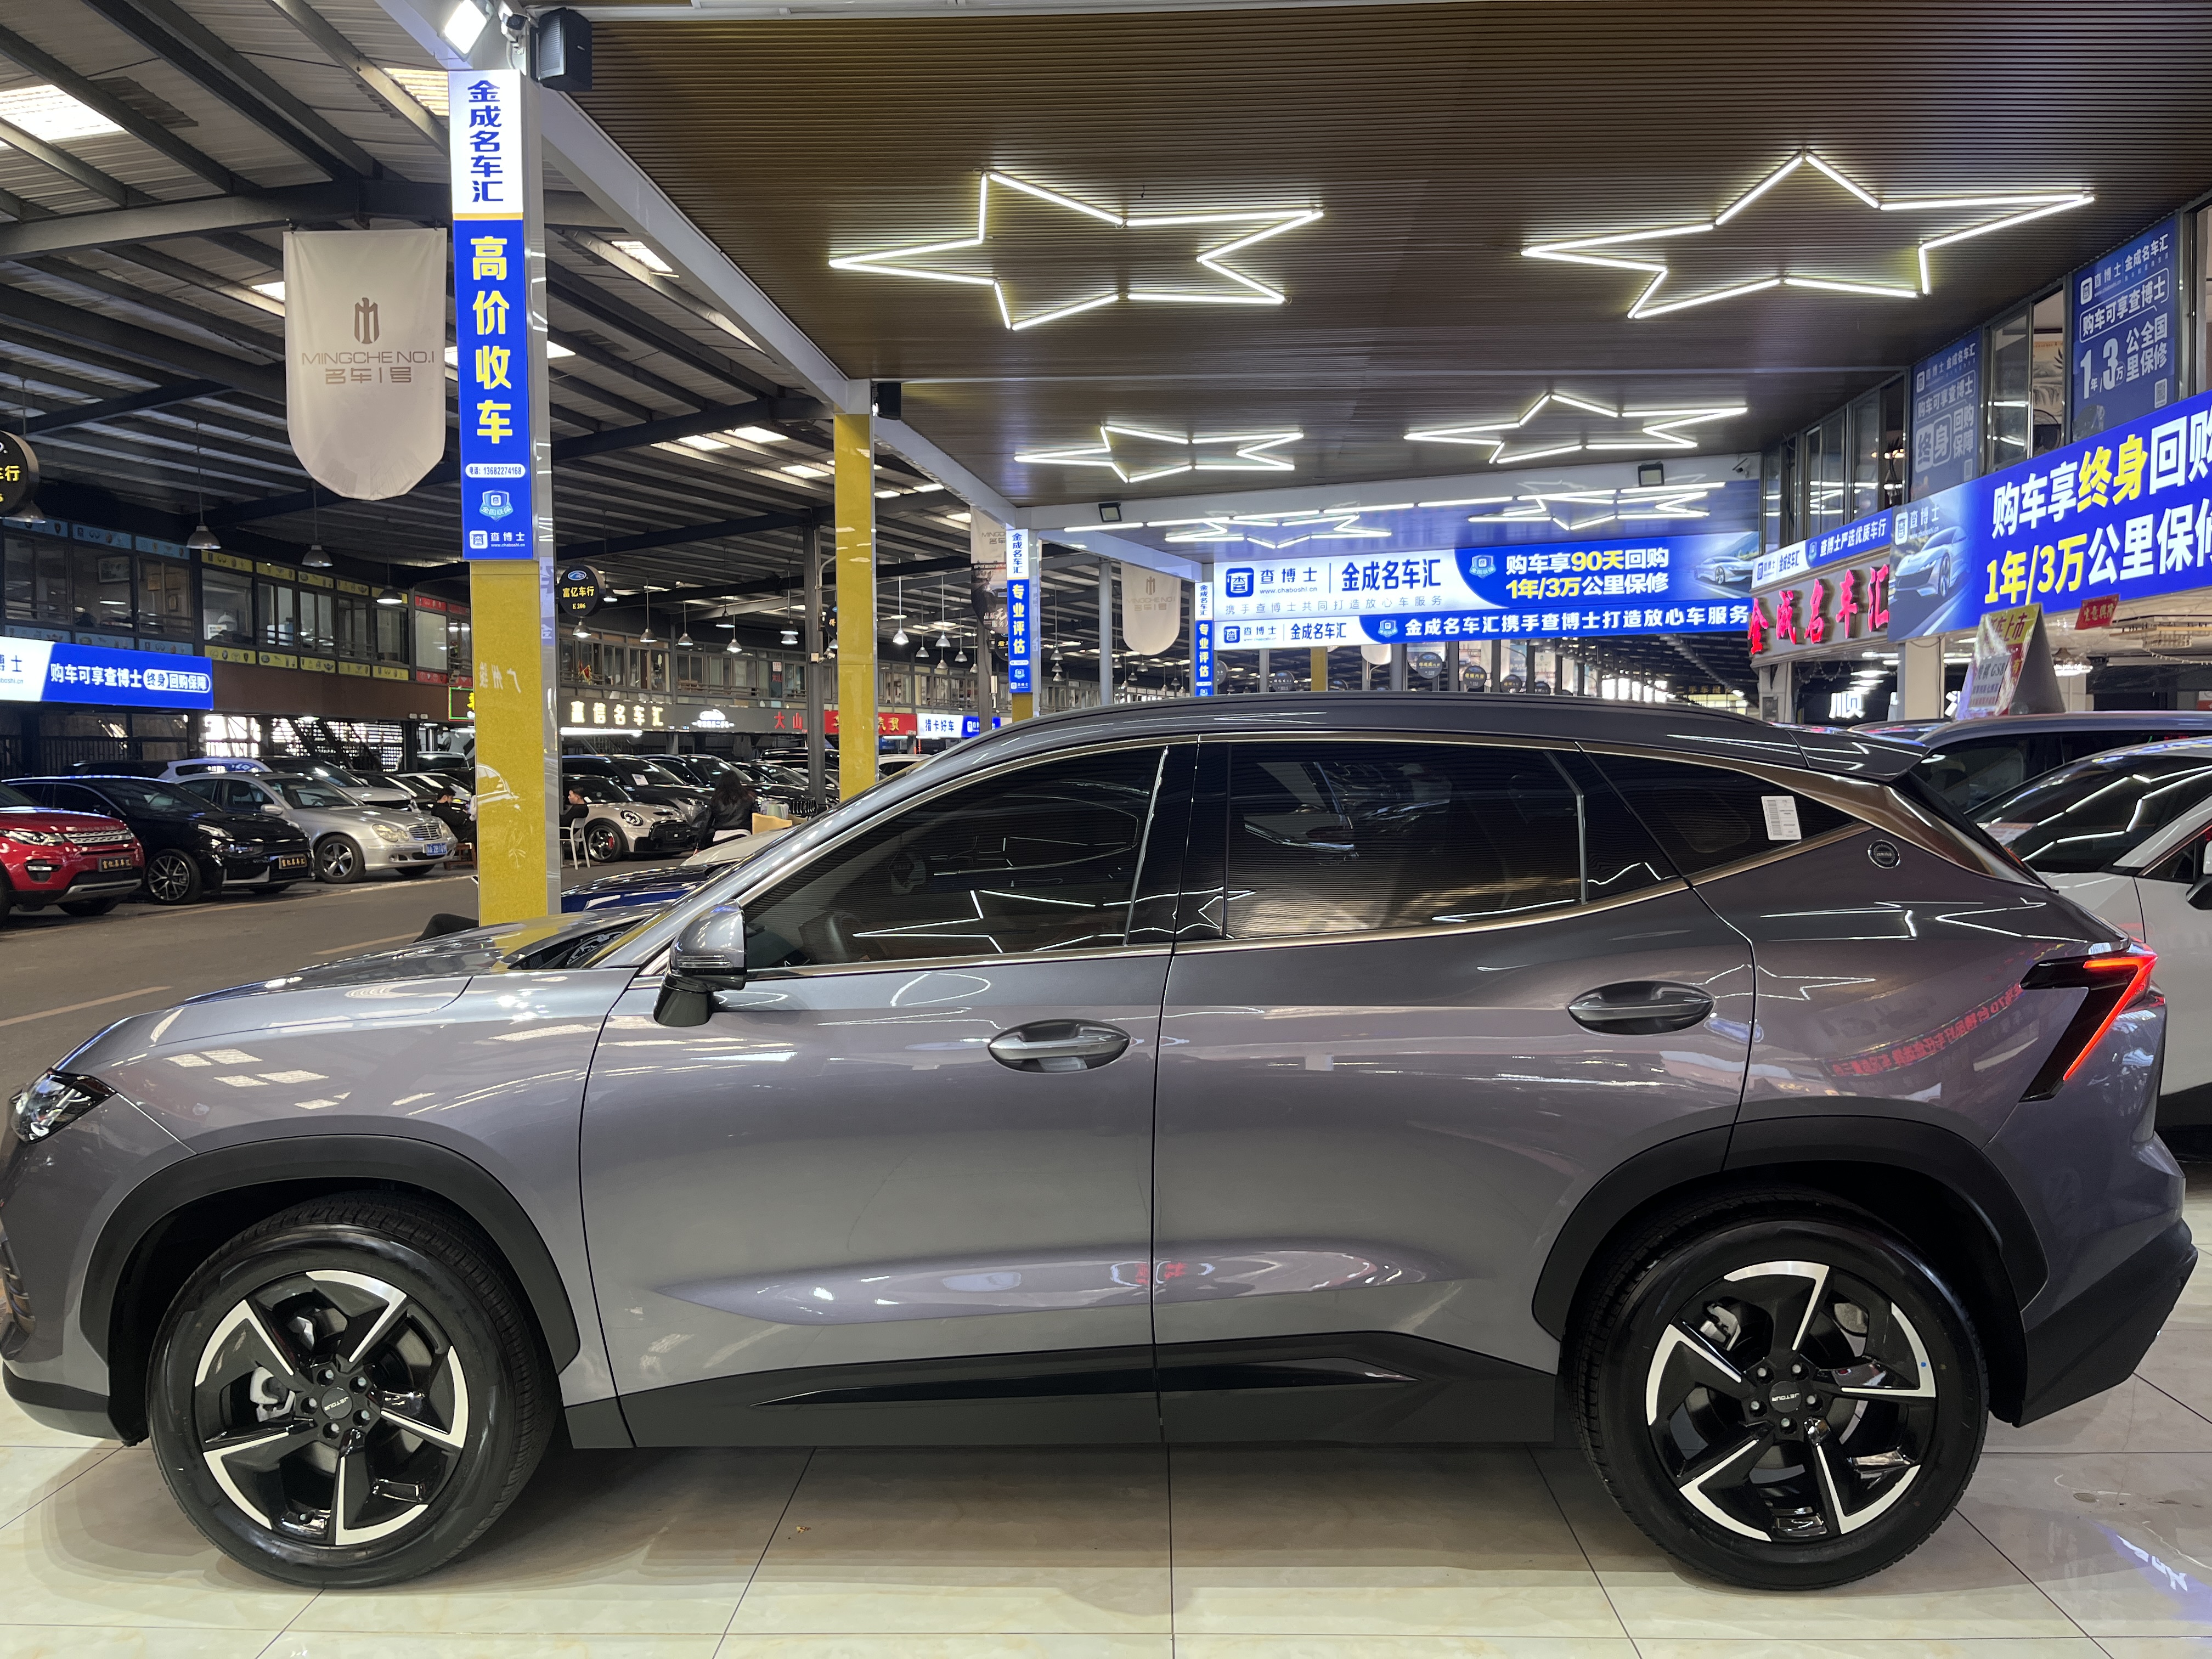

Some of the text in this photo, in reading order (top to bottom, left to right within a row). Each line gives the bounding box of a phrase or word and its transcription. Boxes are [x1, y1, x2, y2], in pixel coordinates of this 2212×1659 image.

[467, 80, 504, 203] 金成名车汇
[2125, 233, 2169, 272] 金成名车汇
[2083, 275, 2166, 337] 购车可享查博士
[470, 235, 514, 444] 高价收车
[302, 351, 393, 365] MINGCHE
[1917, 375, 1973, 419] 购车可享查博士
[490, 532, 525, 541] 查博士
[1819, 517, 1887, 557] 查博士严选优质车行
[1012, 533, 1023, 574] 金成名车汇
[1505, 547, 1669, 575] 购车享90天回购
[1260, 567, 1318, 585] 查博士
[1341, 558, 1442, 592] 金成名车汇
[1505, 572, 1669, 600] 1年/3万公里保修
[562, 586, 595, 599] 富亿车行
[1199, 584, 1209, 616] 金成名车汇
[1225, 595, 1442, 616] 携手查博士共同打造放心车服务
[1012, 584, 1025, 654] 专业评估
[1404, 605, 1750, 637] 金成名车汇携手查博士打造放心车服务
[1747, 564, 1890, 655] 金成名车汇
[1243, 626, 1277, 636] 查博士
[1290, 622, 1347, 640] 金成名车汇
[1199, 623, 1209, 678] 专业评估
[50, 663, 207, 691] 购车可享查博士 终身 回购保障
[774, 711, 803, 730] 大山
[324, 1396, 349, 1412] JETOUR
[1771, 1392, 1801, 1402] JETOUR
